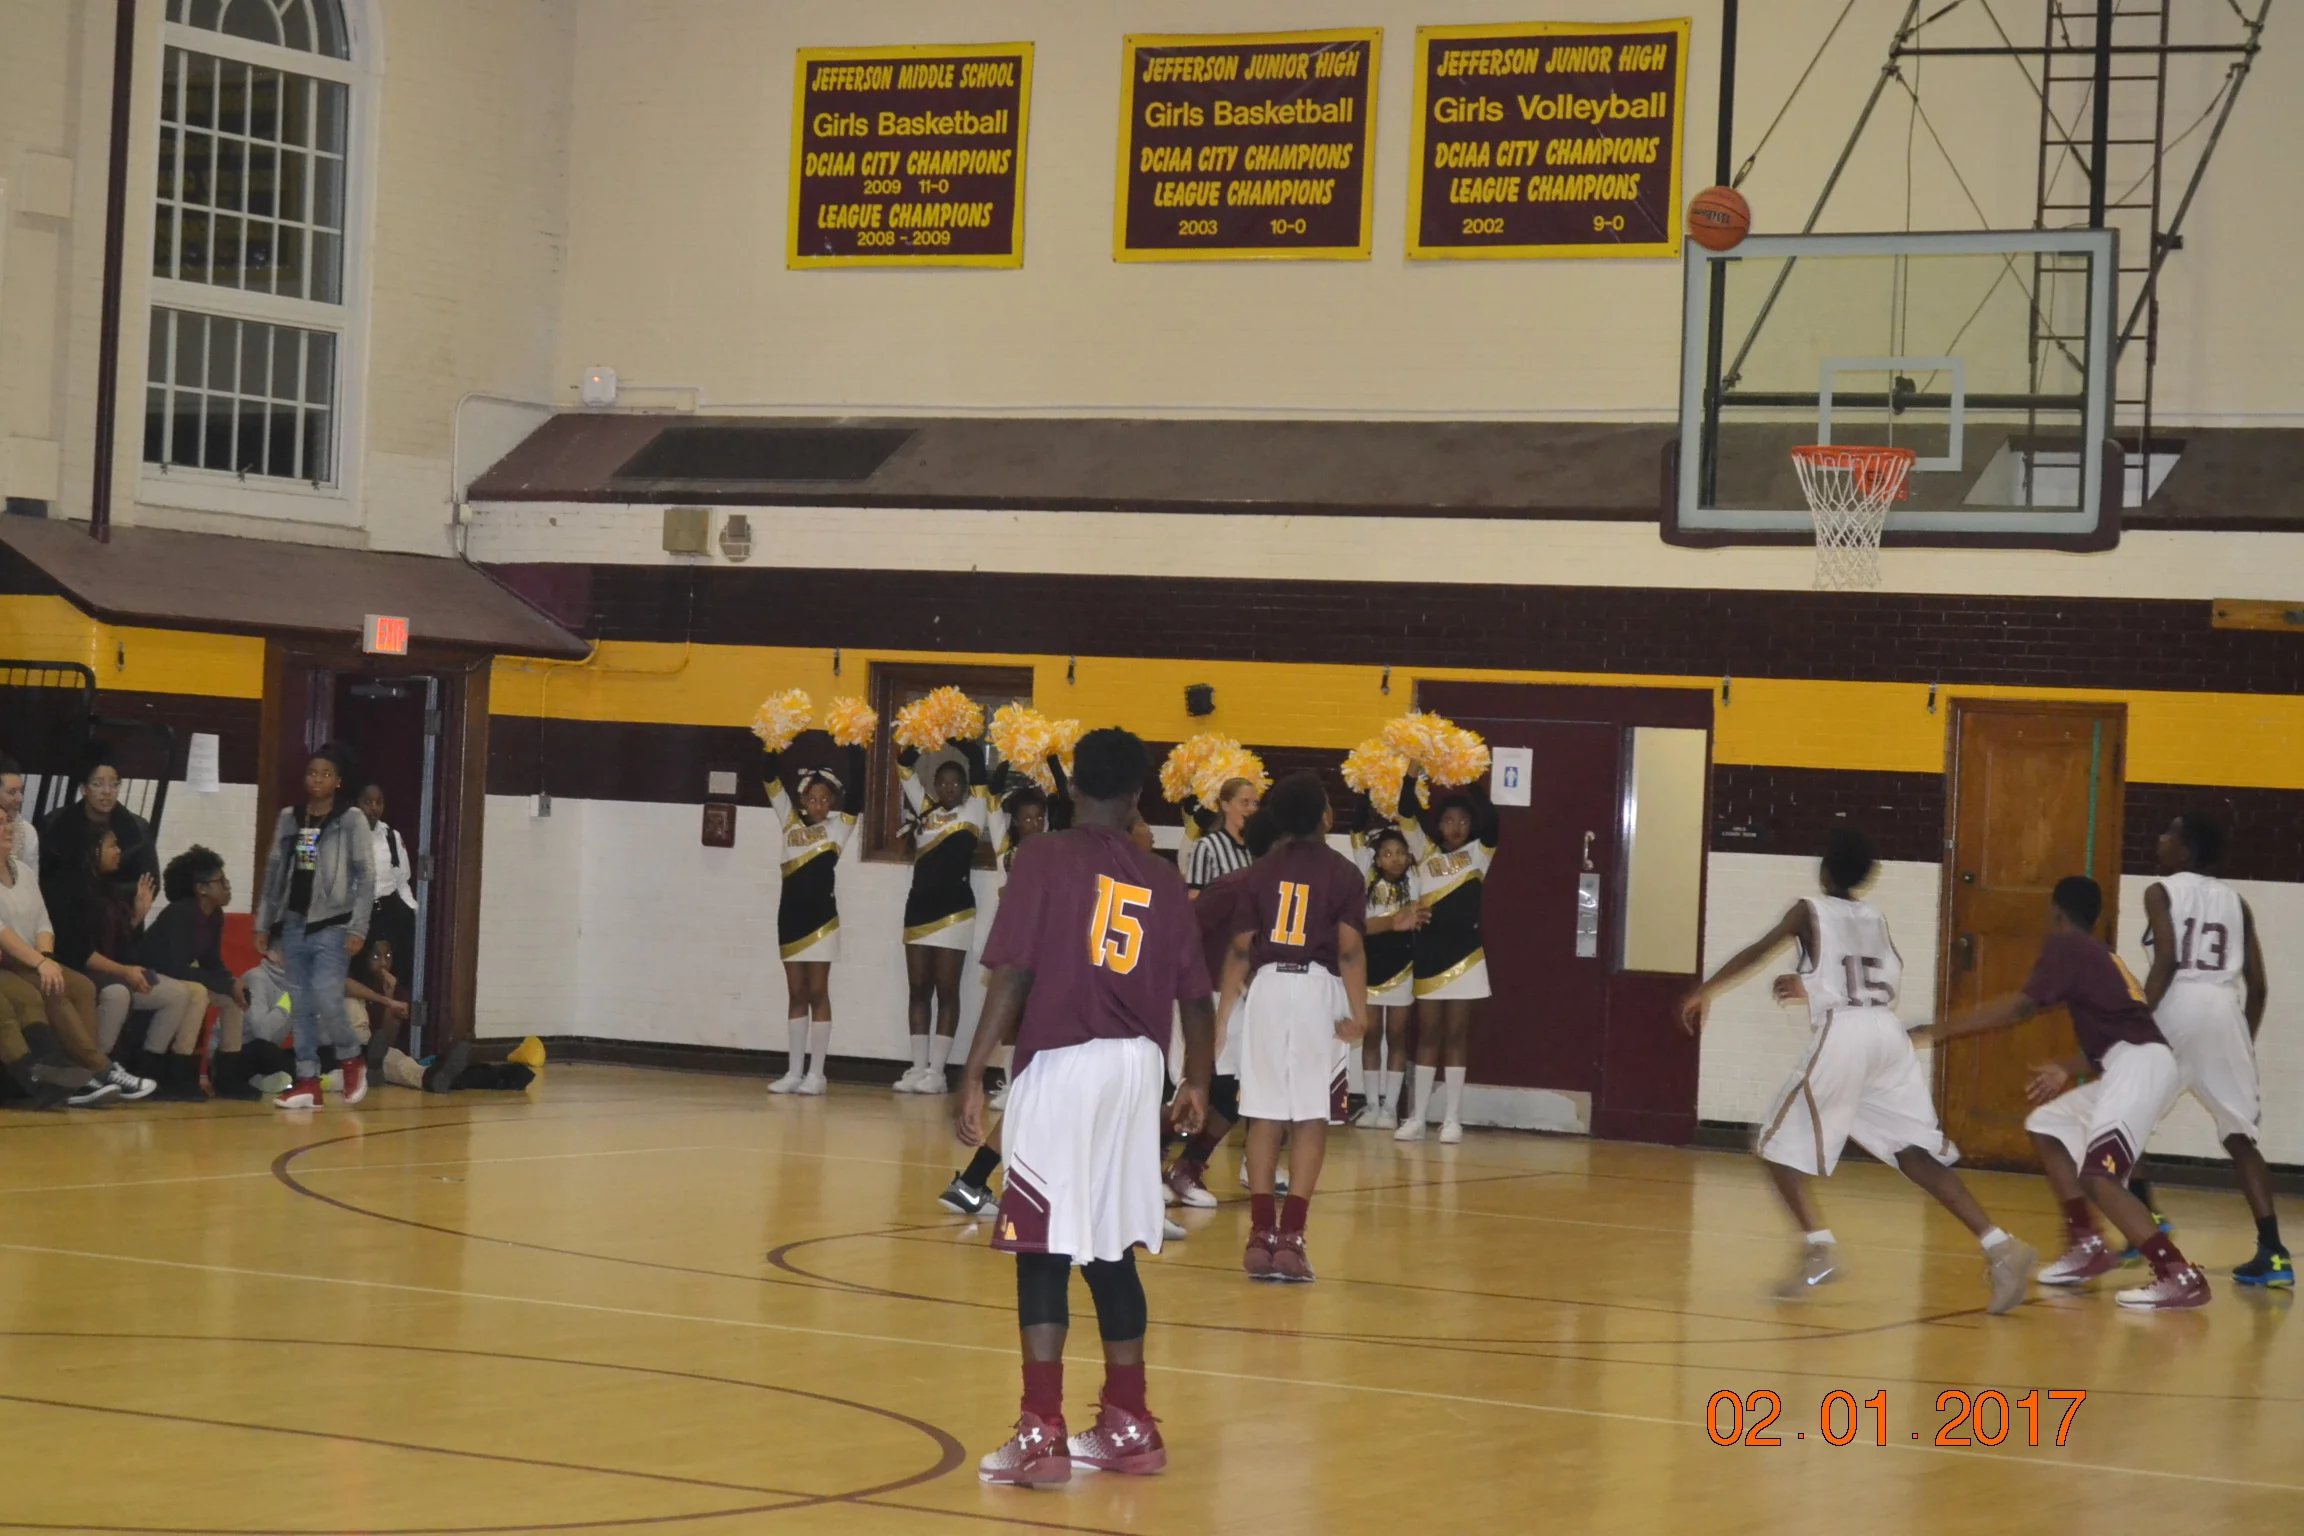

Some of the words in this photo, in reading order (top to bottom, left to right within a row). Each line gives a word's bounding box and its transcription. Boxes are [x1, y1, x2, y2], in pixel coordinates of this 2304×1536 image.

[1142, 56, 1240, 83] JEFFERSON
[1244, 53, 1311, 80] JUNIOR
[1315, 51, 1360, 78] HIGH
[1437, 48, 1541, 77] JEFFERSON
[1545, 45, 1614, 74] JUNIOR
[1618, 44, 1668, 72] HIGH
[812, 65, 894, 92] JEFFERSON
[897, 63, 955, 89] MIDDLE
[959, 63, 1015, 88] SCHOOL
[813, 112, 870, 138] Girls
[877, 109, 1009, 137] Basketball
[1144, 102, 1205, 128] Girls
[1214, 97, 1354, 127] Basketball
[1434, 96, 1504, 124] Girls
[1518, 91, 1668, 125] Volleyball
[803, 149, 857, 177] DCIAA
[860, 151, 902, 177] CITY
[906, 148, 1013, 176] CHAMPIONS
[1140, 146, 1193, 174] DCIAA
[1198, 146, 1239, 172] CITY
[1244, 143, 1355, 172] CHAMPIONS
[1434, 141, 1491, 169] DCIAA
[1495, 140, 1541, 168] CITY
[1545, 136, 1661, 166] CHAMPIONS
[864, 179, 903, 195] 2009
[919, 178, 950, 194] 11-0
[1153, 181, 1222, 208] LEAGUE
[1227, 178, 1336, 207] CHAMPIONS
[1449, 176, 1521, 205] LEAGUE
[1527, 173, 1641, 203] CHAMPIONS
[817, 203, 884, 231] LEAGUE
[888, 202, 995, 230] CHAMPIONS
[1179, 220, 1218, 236] 2003
[1271, 218, 1307, 235] 10-0
[1463, 218, 1505, 235] 2002
[1593, 215, 1625, 232] 9-0
[857, 230, 896, 247] 2008
[913, 229, 952, 247] 2009
[376, 617, 406, 652] EXIT
[1090, 873, 1152, 975] 15
[1270, 881, 1310, 946] 11
[2177, 917, 2228, 971] 13
[1841, 954, 1896, 1007] 15
